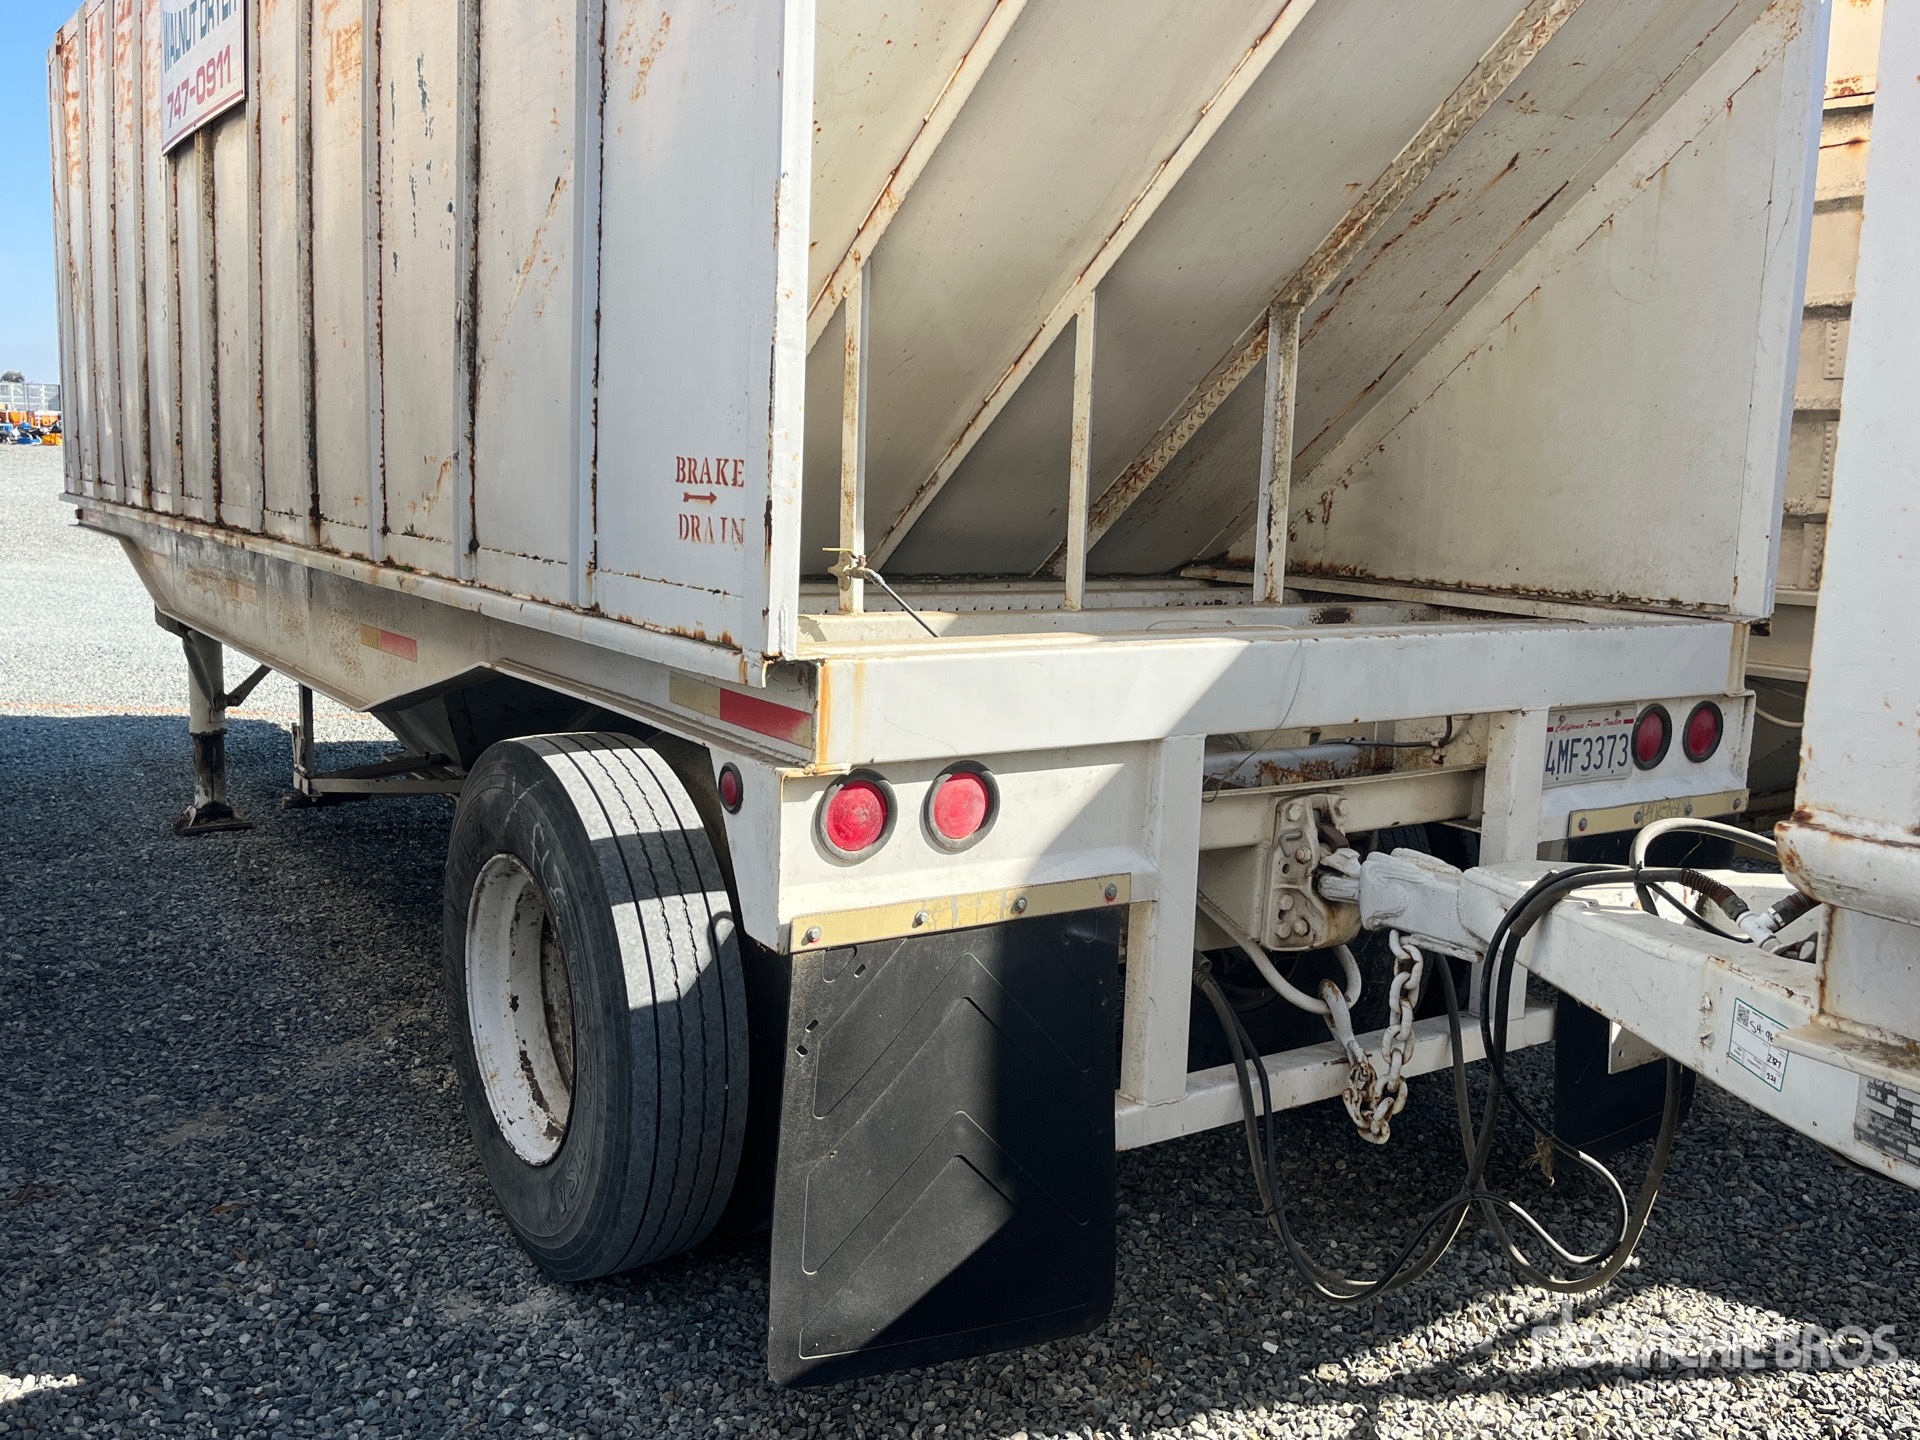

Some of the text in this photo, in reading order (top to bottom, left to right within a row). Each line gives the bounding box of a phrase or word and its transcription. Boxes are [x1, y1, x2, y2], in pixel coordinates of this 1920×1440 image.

[163, 0, 197, 74] WALNUT
[167, 44, 231, 128] 747-0911
[675, 455, 745, 488] BRAKE
[678, 513, 746, 545] DRAIN
[1554, 721, 1585, 733] California
[1603, 717, 1622, 727] Trailer
[1545, 733, 1629, 776] 4MF3373
